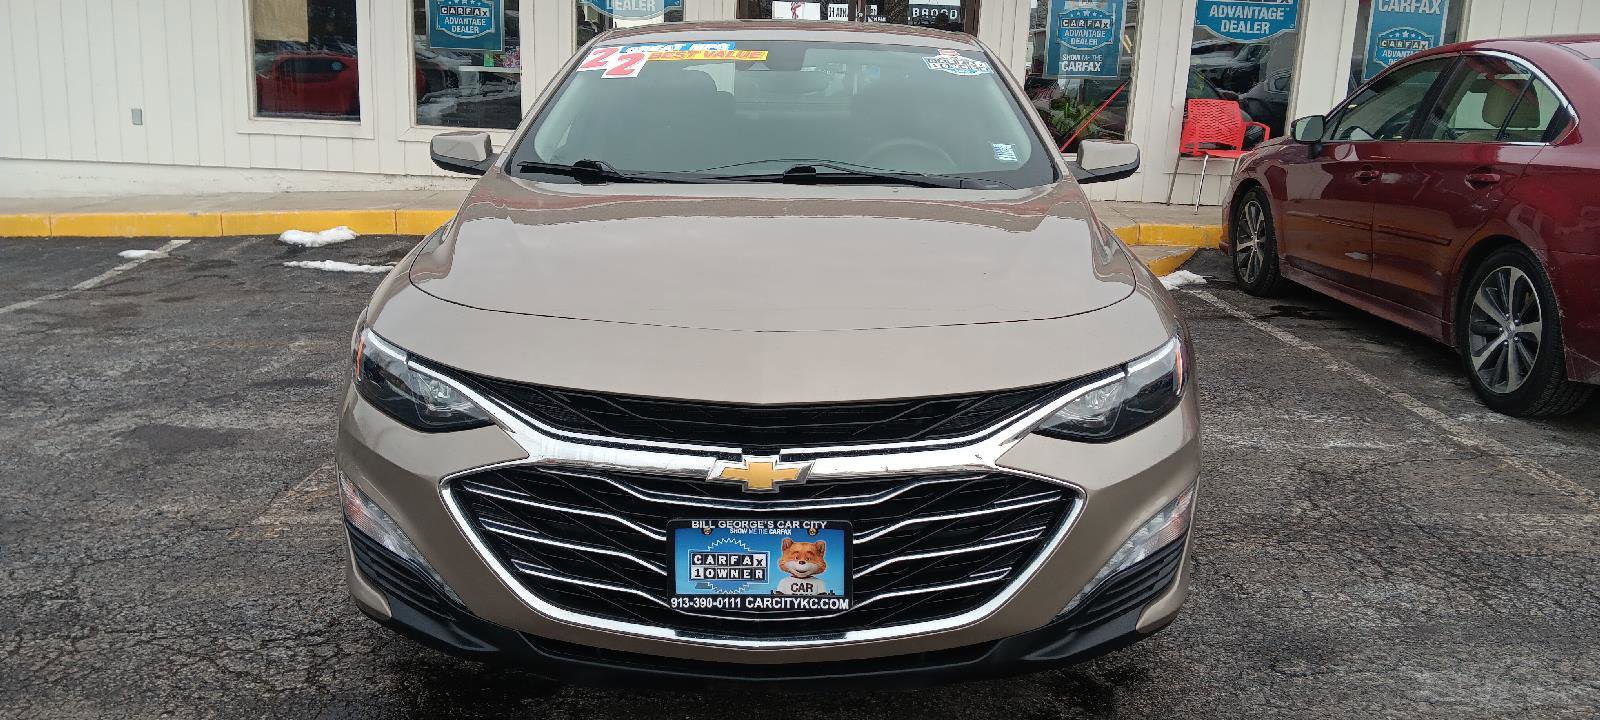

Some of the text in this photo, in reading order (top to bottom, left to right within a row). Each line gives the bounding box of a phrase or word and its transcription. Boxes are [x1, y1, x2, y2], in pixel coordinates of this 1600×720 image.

[441, 7, 489, 17] CARFAX
[1209, 5, 1285, 20] ADVANTAGE
[1379, 0, 1441, 15] CARFAX
[444, 16, 487, 26] ADVANTAGE
[1062, 19, 1110, 28] CARFAX
[452, 25, 480, 34] DEALER
[1220, 20, 1271, 34] DEALER
[1064, 29, 1106, 38] ADVANTAGE
[1070, 38, 1098, 46] DEALER
[1381, 40, 1429, 50] CARFAX
[648, 51, 766, 59] BEST VALUE
[1061, 61, 1102, 72] CARFAX
[692, 520, 828, 530] BILL GEORGE'S CAR CITY
[693, 554, 765, 567] CARFAX
[705, 569, 764, 579] OWNER
[790, 582, 814, 592] CAR
[671, 597, 850, 610] 913-390-0111 CARCITYKC.COM
